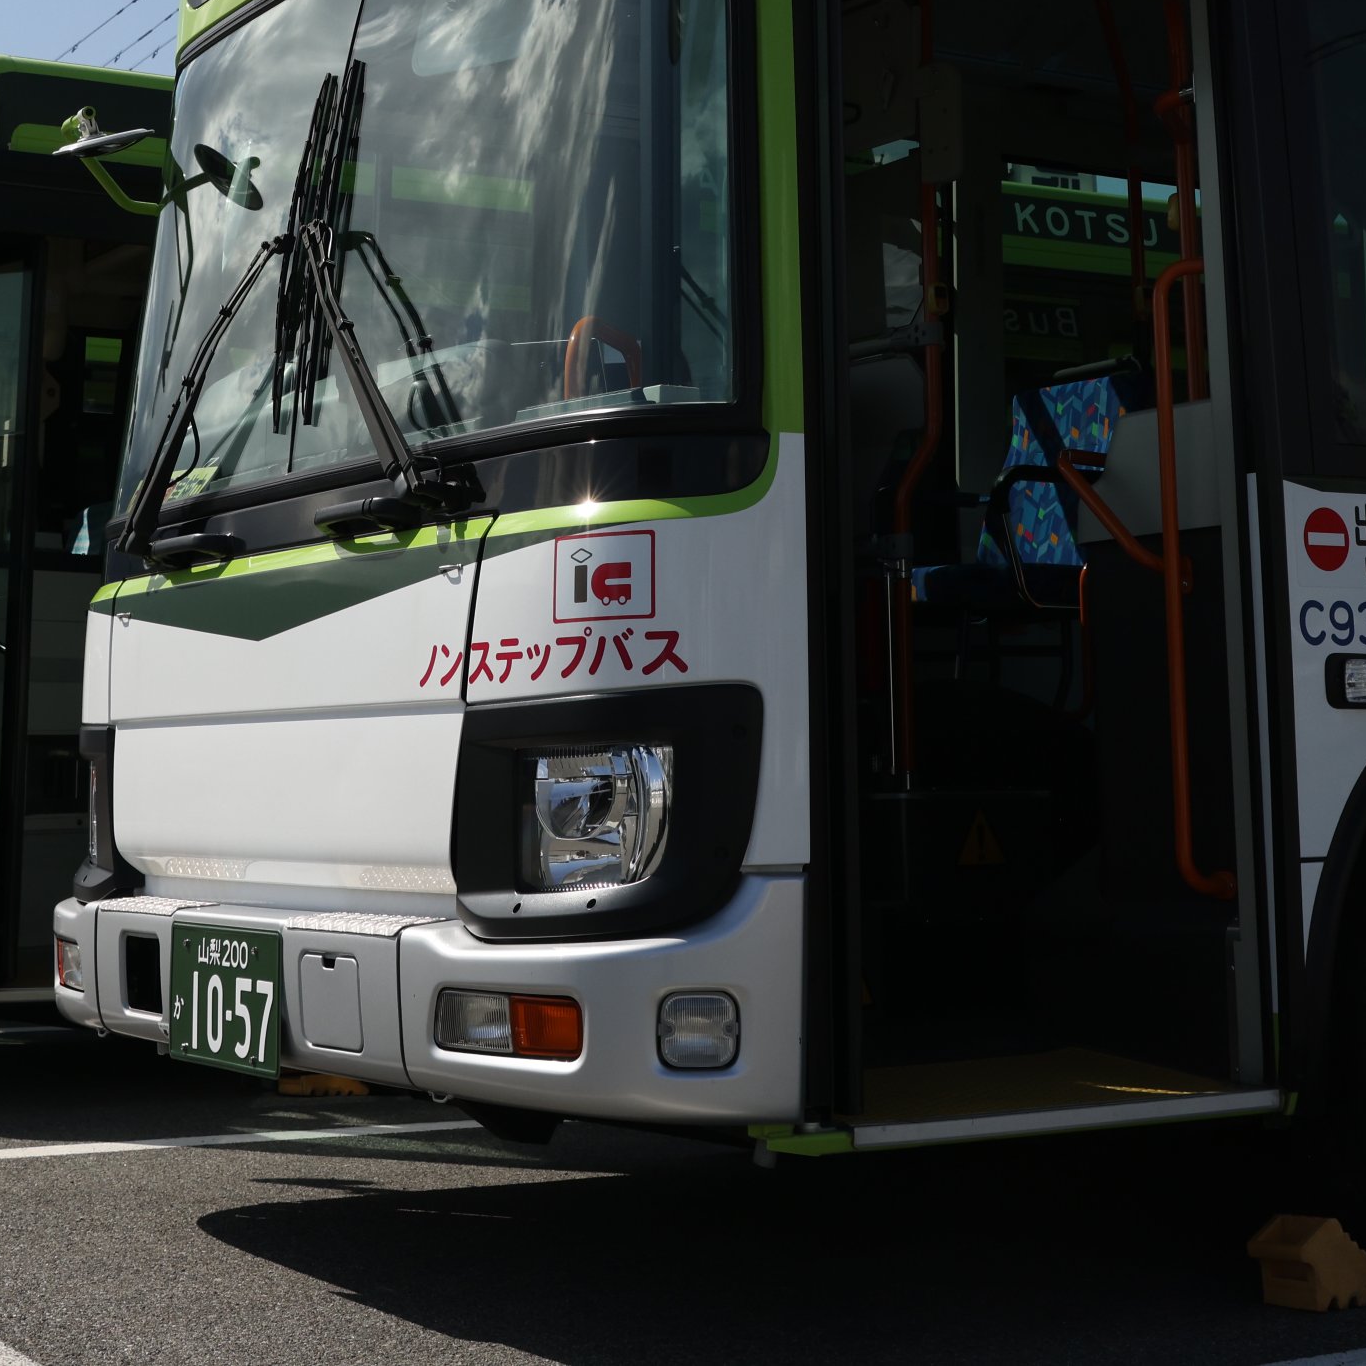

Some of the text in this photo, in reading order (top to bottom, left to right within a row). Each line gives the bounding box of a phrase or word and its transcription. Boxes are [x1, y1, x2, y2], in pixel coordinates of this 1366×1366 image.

[419, 626, 688, 687] ノンステップバス
[198, 937, 249, 969] 山梨200
[173, 971, 274, 1063] か 10-57
